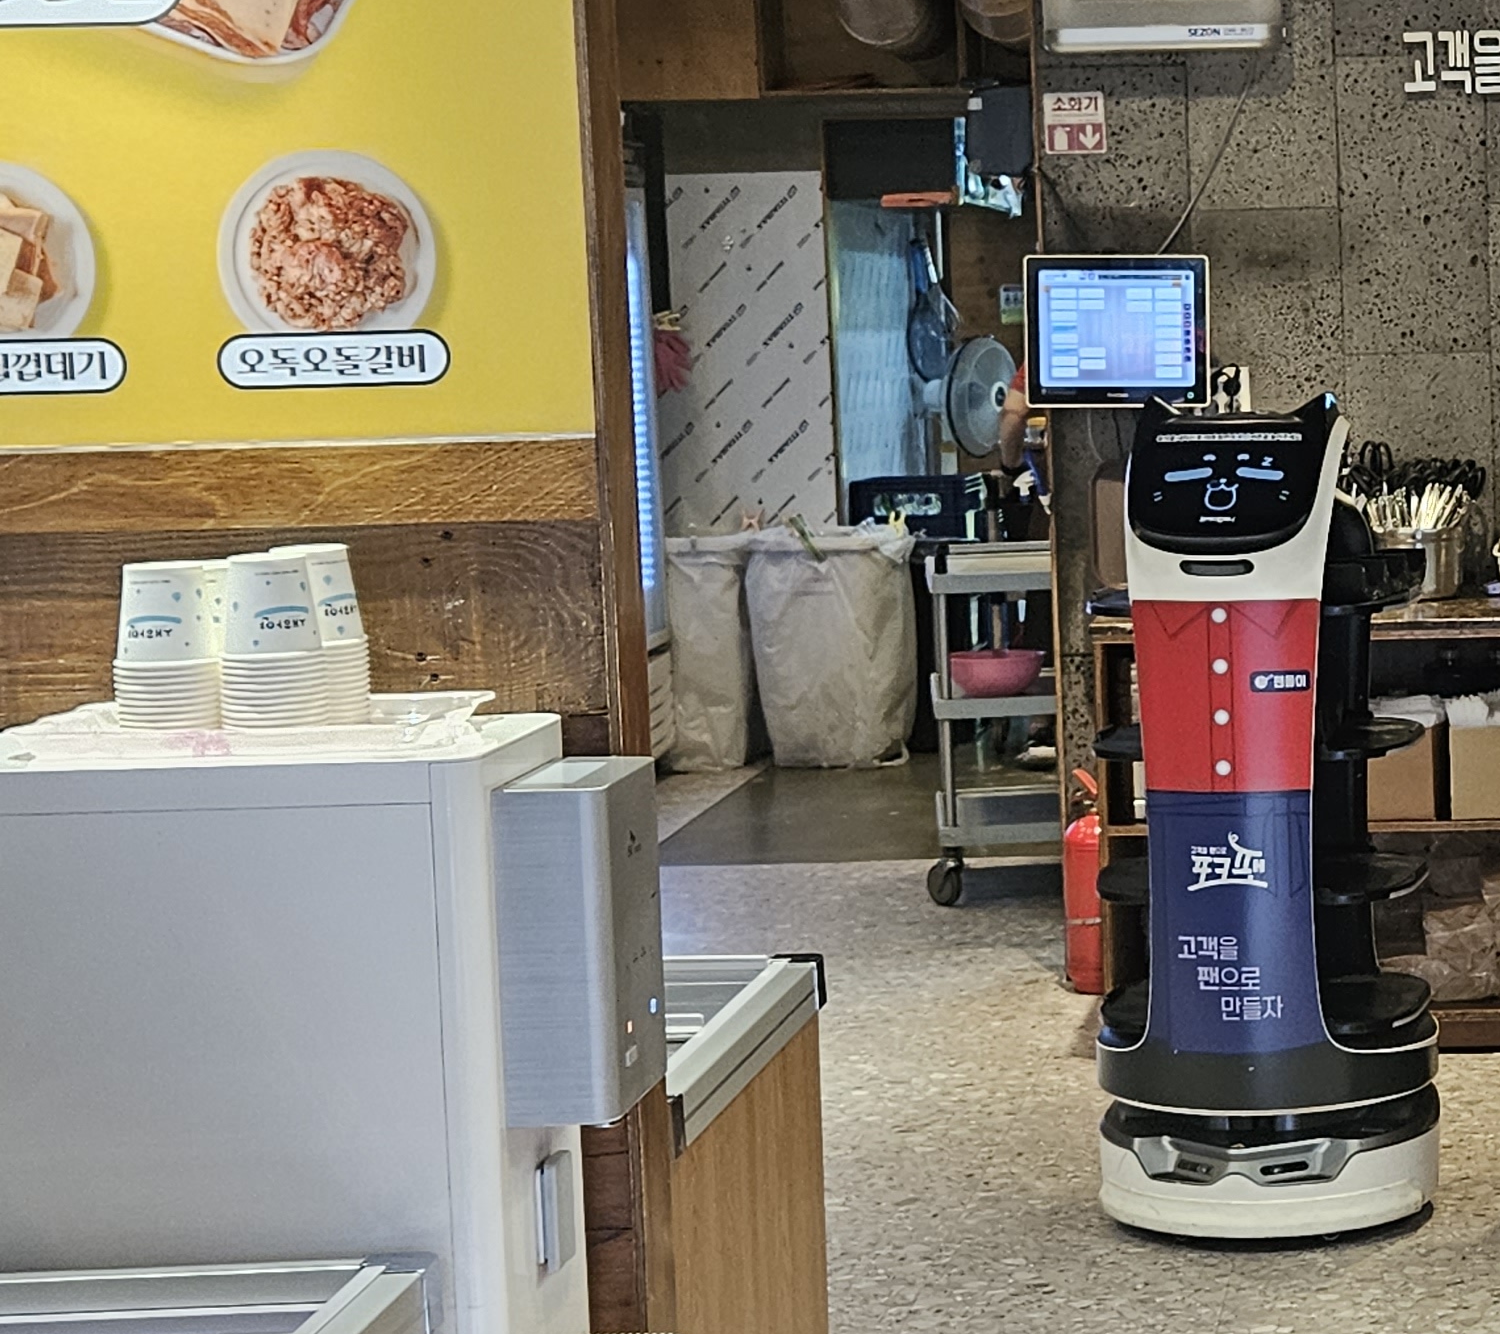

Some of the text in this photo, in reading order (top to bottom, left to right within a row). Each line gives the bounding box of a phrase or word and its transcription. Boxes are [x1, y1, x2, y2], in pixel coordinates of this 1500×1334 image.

[1051, 96, 1099, 112] 소화기
[236, 344, 426, 377] 오독오돌갈비
[1186, 830, 1269, 892] 포크팬
[1177, 934, 1239, 961] 고객을
[1196, 966, 1261, 991] 팬으로
[1220, 994, 1284, 1021] 만들자
